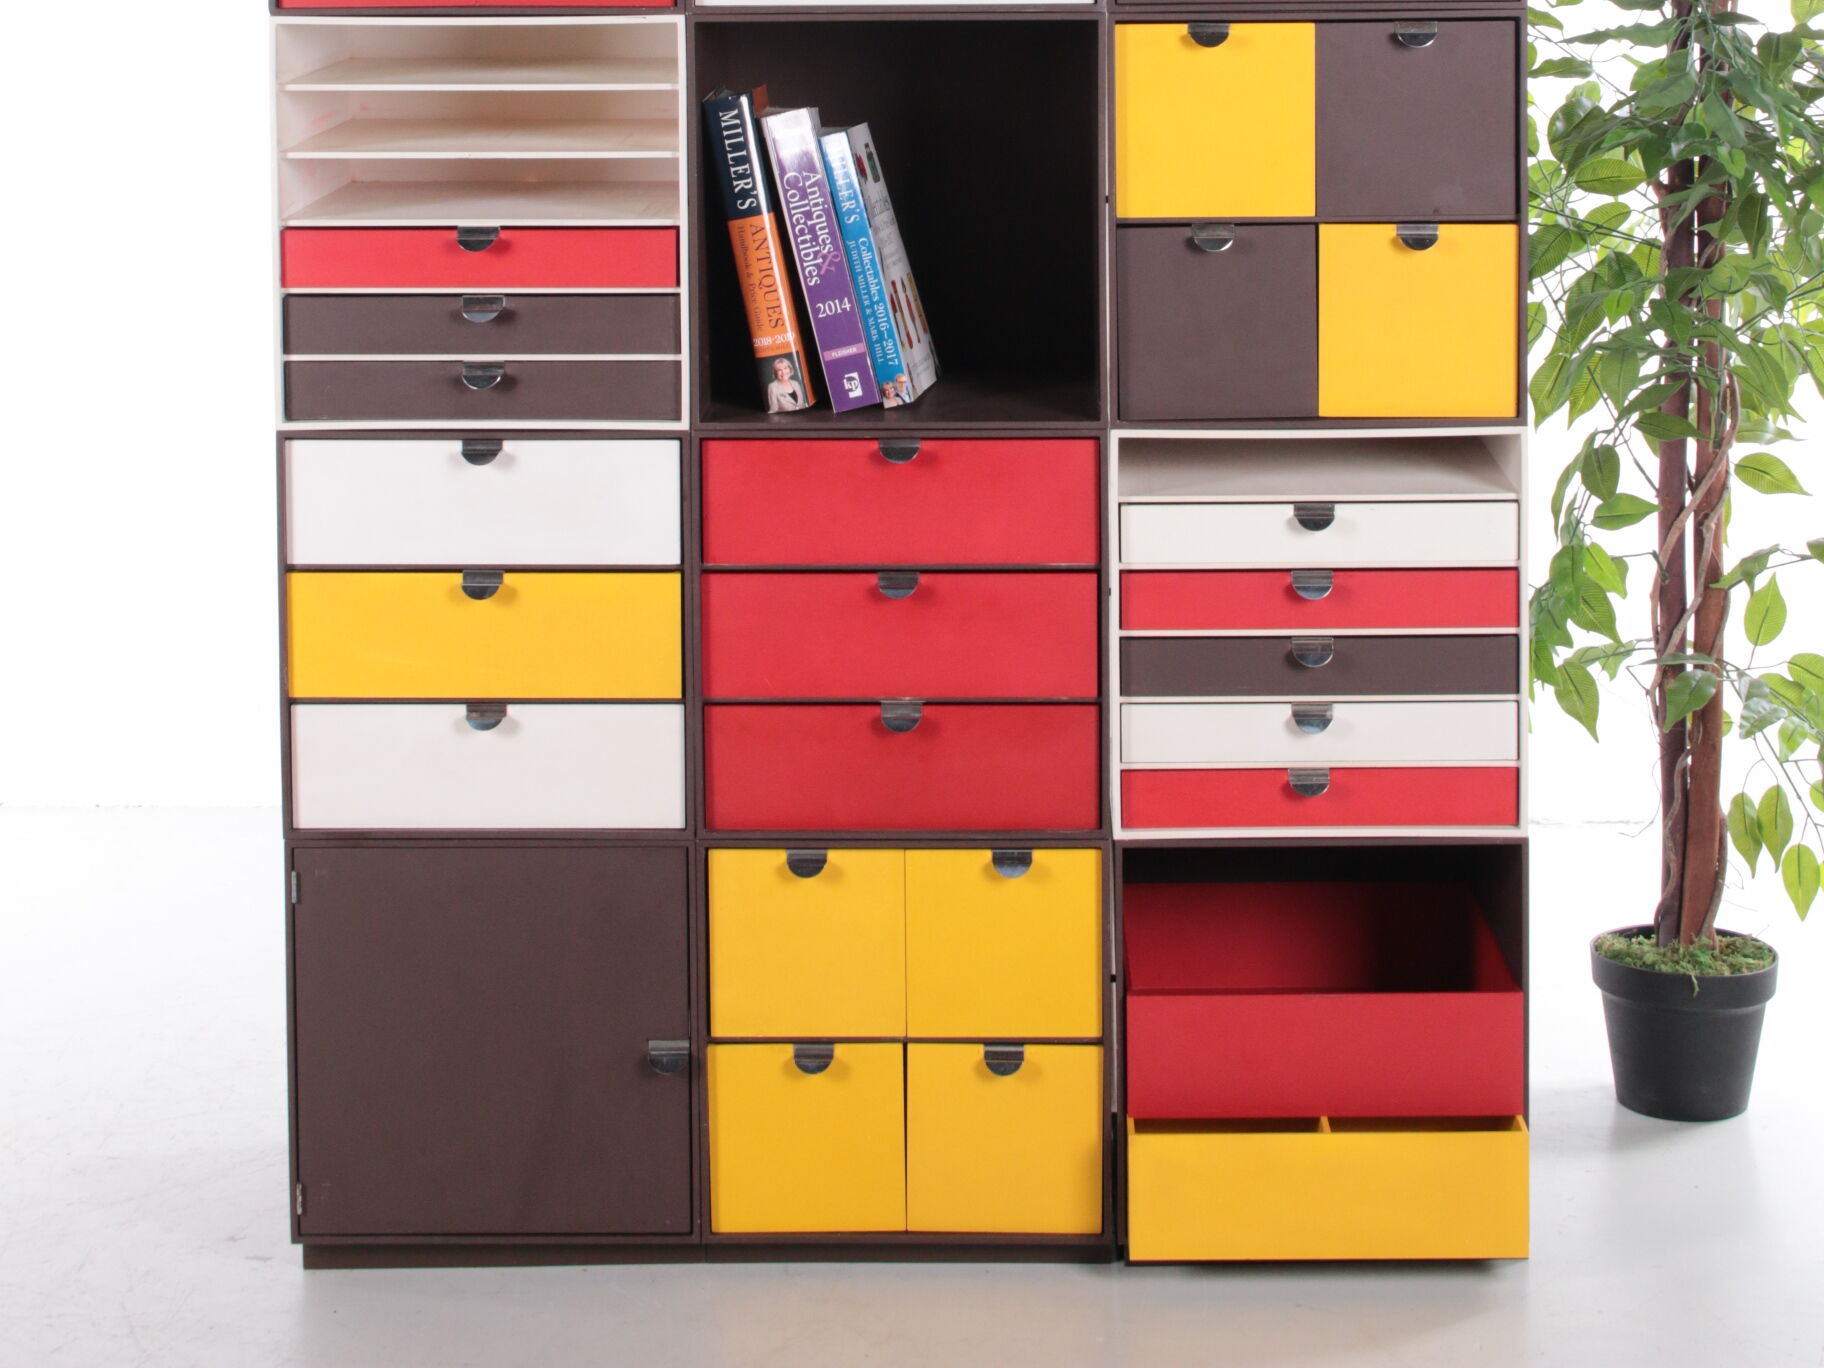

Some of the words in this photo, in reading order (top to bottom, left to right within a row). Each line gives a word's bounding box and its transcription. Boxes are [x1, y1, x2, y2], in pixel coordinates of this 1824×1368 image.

[719, 108, 757, 209] MILLER'S
[737, 226, 752, 269] Handbook
[783, 172, 824, 286] Collectibles
[803, 172, 833, 254] Antiques
[750, 224, 785, 329] ANTIQUES
[817, 251, 840, 275] &
[847, 239, 861, 272] JUDITH
[858, 274, 871, 306] MILLER
[868, 316, 879, 342] MARK
[874, 343, 884, 364] HILL
[858, 237, 879, 302] Collectables
[816, 297, 851, 318] 2014
